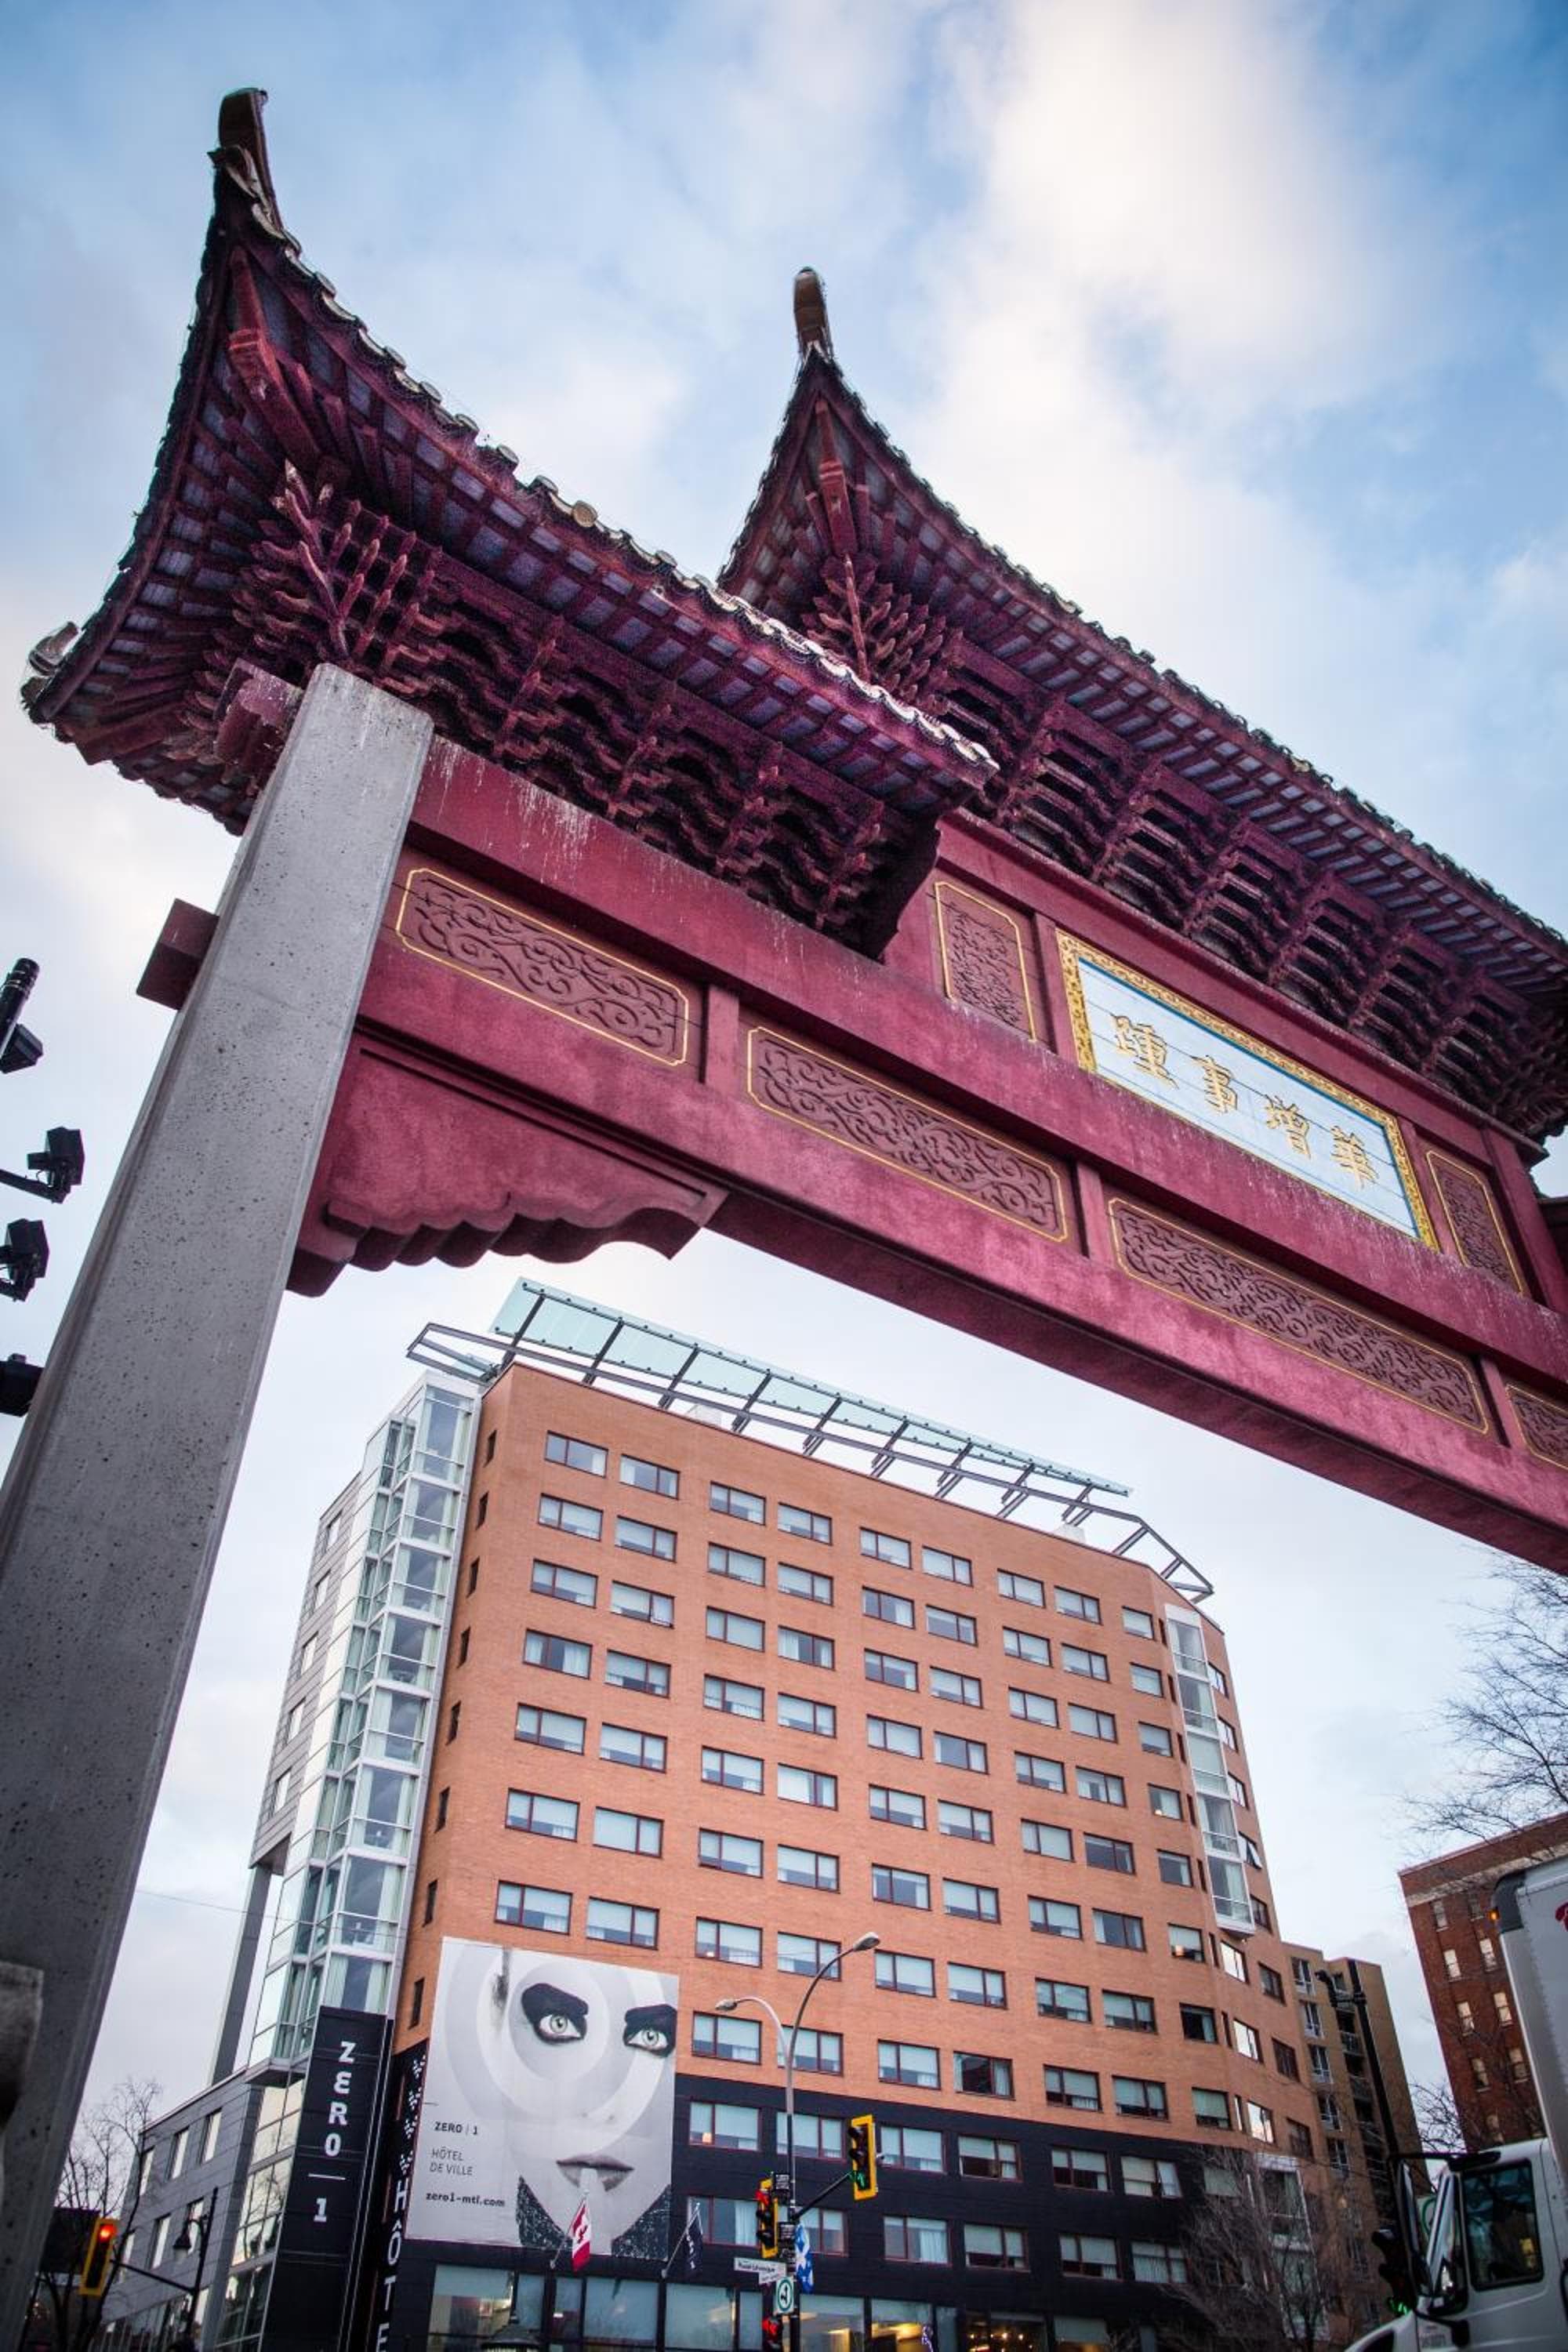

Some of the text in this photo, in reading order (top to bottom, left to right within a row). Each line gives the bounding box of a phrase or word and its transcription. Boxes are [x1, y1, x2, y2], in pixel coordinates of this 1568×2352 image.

[314, 2040, 357, 2223] ZERO 1
[434, 2121, 479, 2136] ZERO 1
[431, 2146, 463, 2161] HÔTEL
[429, 2162, 474, 2176] DE VILLE
[426, 2191, 506, 2207] zero1-mtl.com
